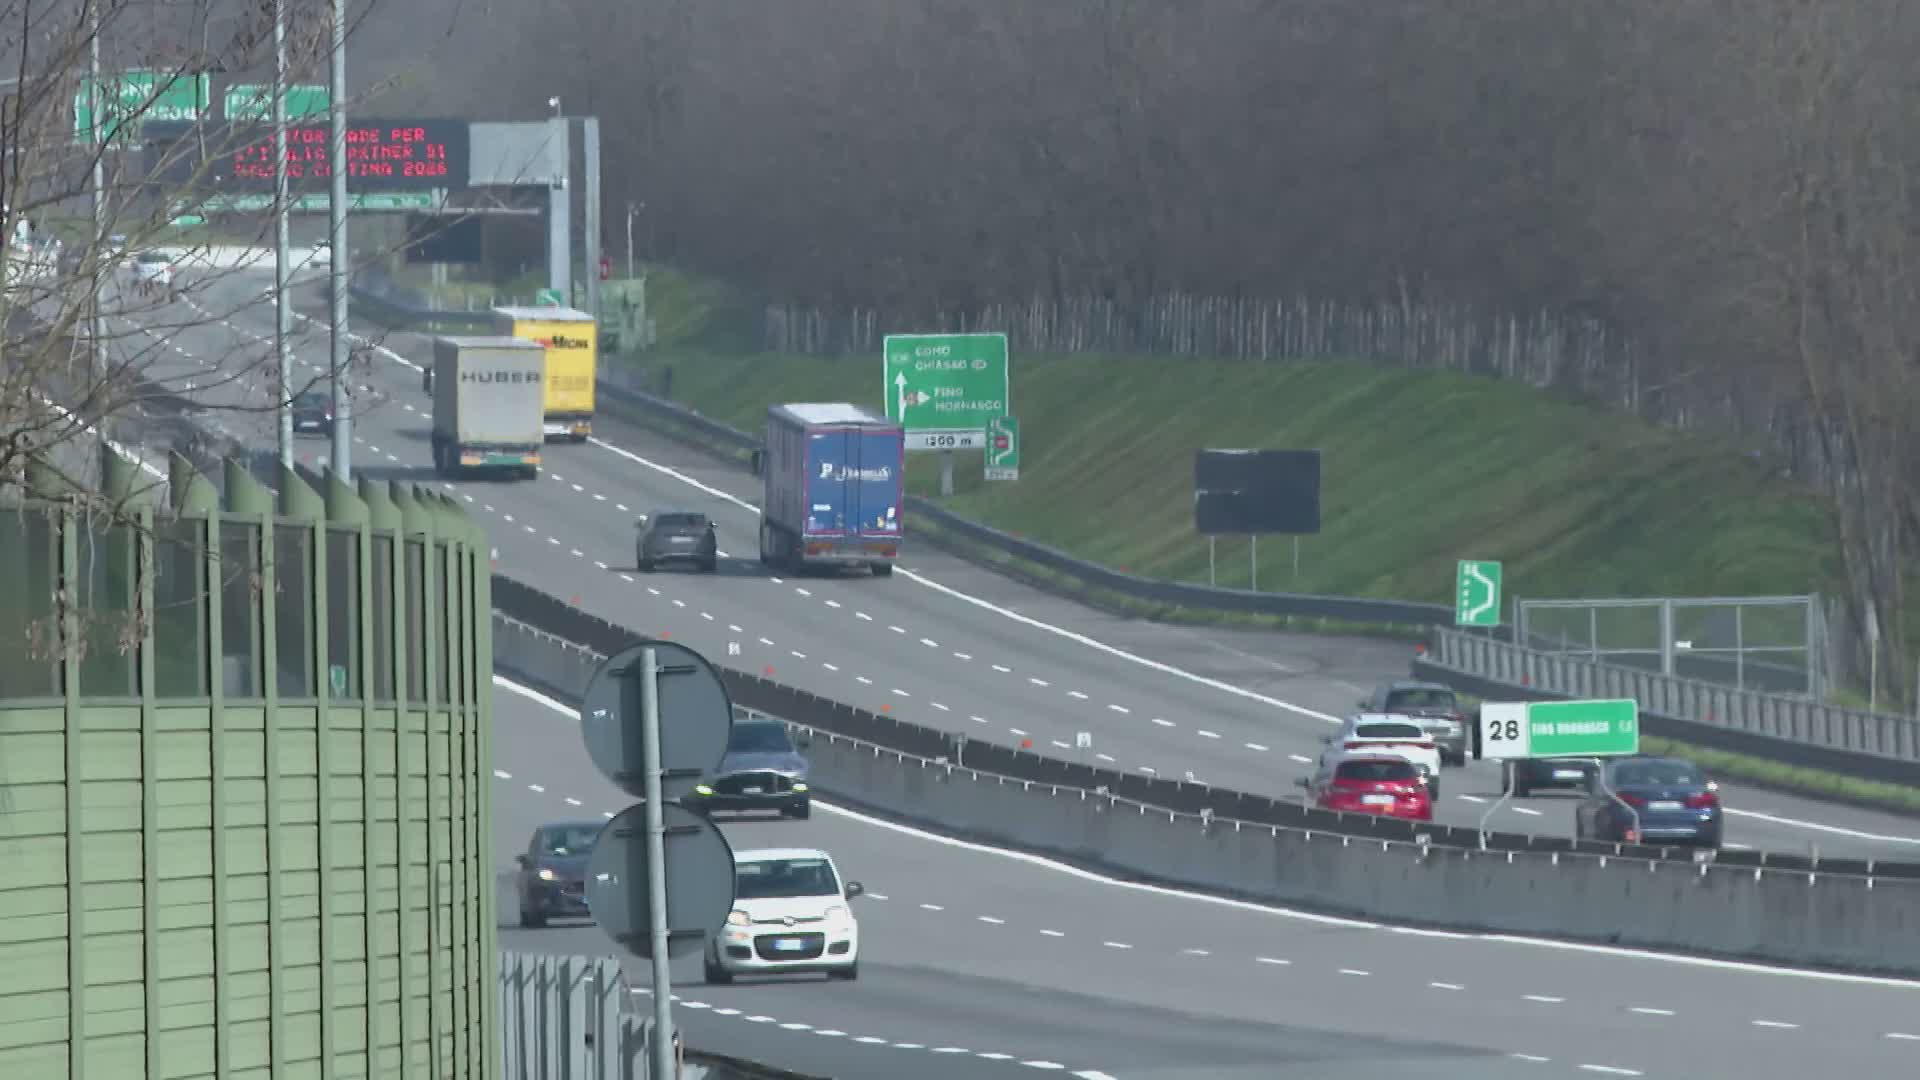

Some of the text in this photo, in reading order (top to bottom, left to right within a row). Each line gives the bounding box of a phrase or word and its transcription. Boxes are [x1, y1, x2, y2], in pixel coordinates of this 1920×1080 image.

[391, 128, 425, 142] PER
[462, 371, 541, 384] HUBER
[1489, 720, 1519, 740] 28
